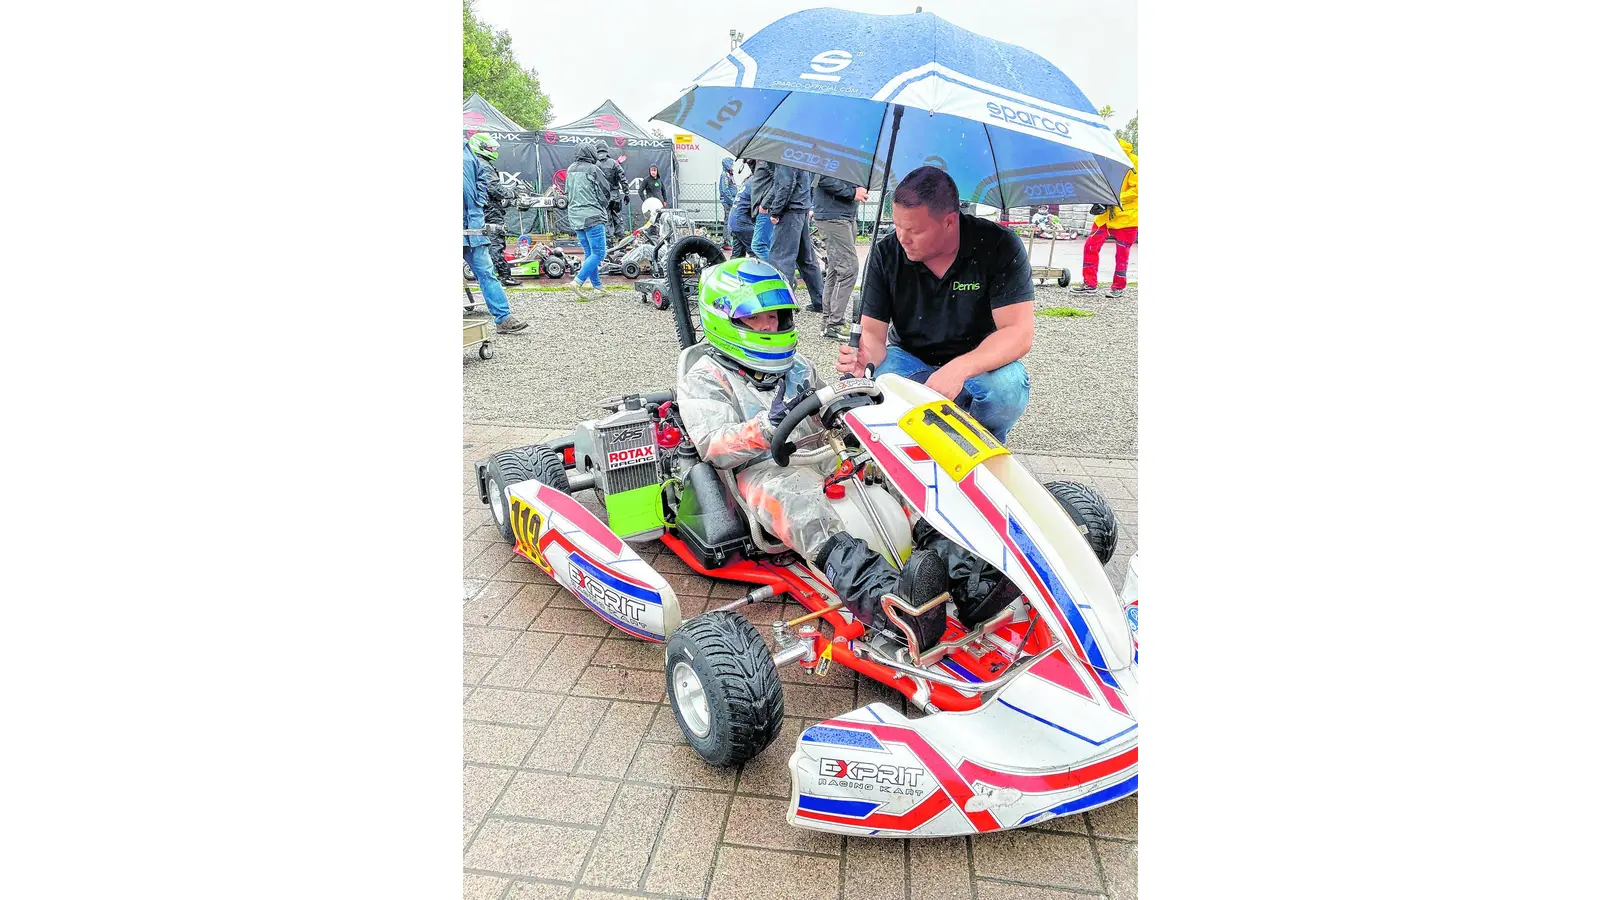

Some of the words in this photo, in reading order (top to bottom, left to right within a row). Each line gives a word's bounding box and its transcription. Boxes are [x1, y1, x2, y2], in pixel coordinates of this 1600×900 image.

[986, 101, 1070, 137] sparco
[627, 139, 665, 148] 24MX
[675, 143, 700, 151] ROTAX
[531, 266, 537, 274] 5
[610, 428, 645, 444] XPS
[922, 403, 1003, 457] 11
[608, 445, 653, 463] ROTAX
[610, 456, 654, 469] RACING
[568, 562, 646, 621] EXPRIT
[819, 757, 924, 787] EXPRIT
[818, 778, 874, 791] RACING
[879, 785, 924, 797] KART
